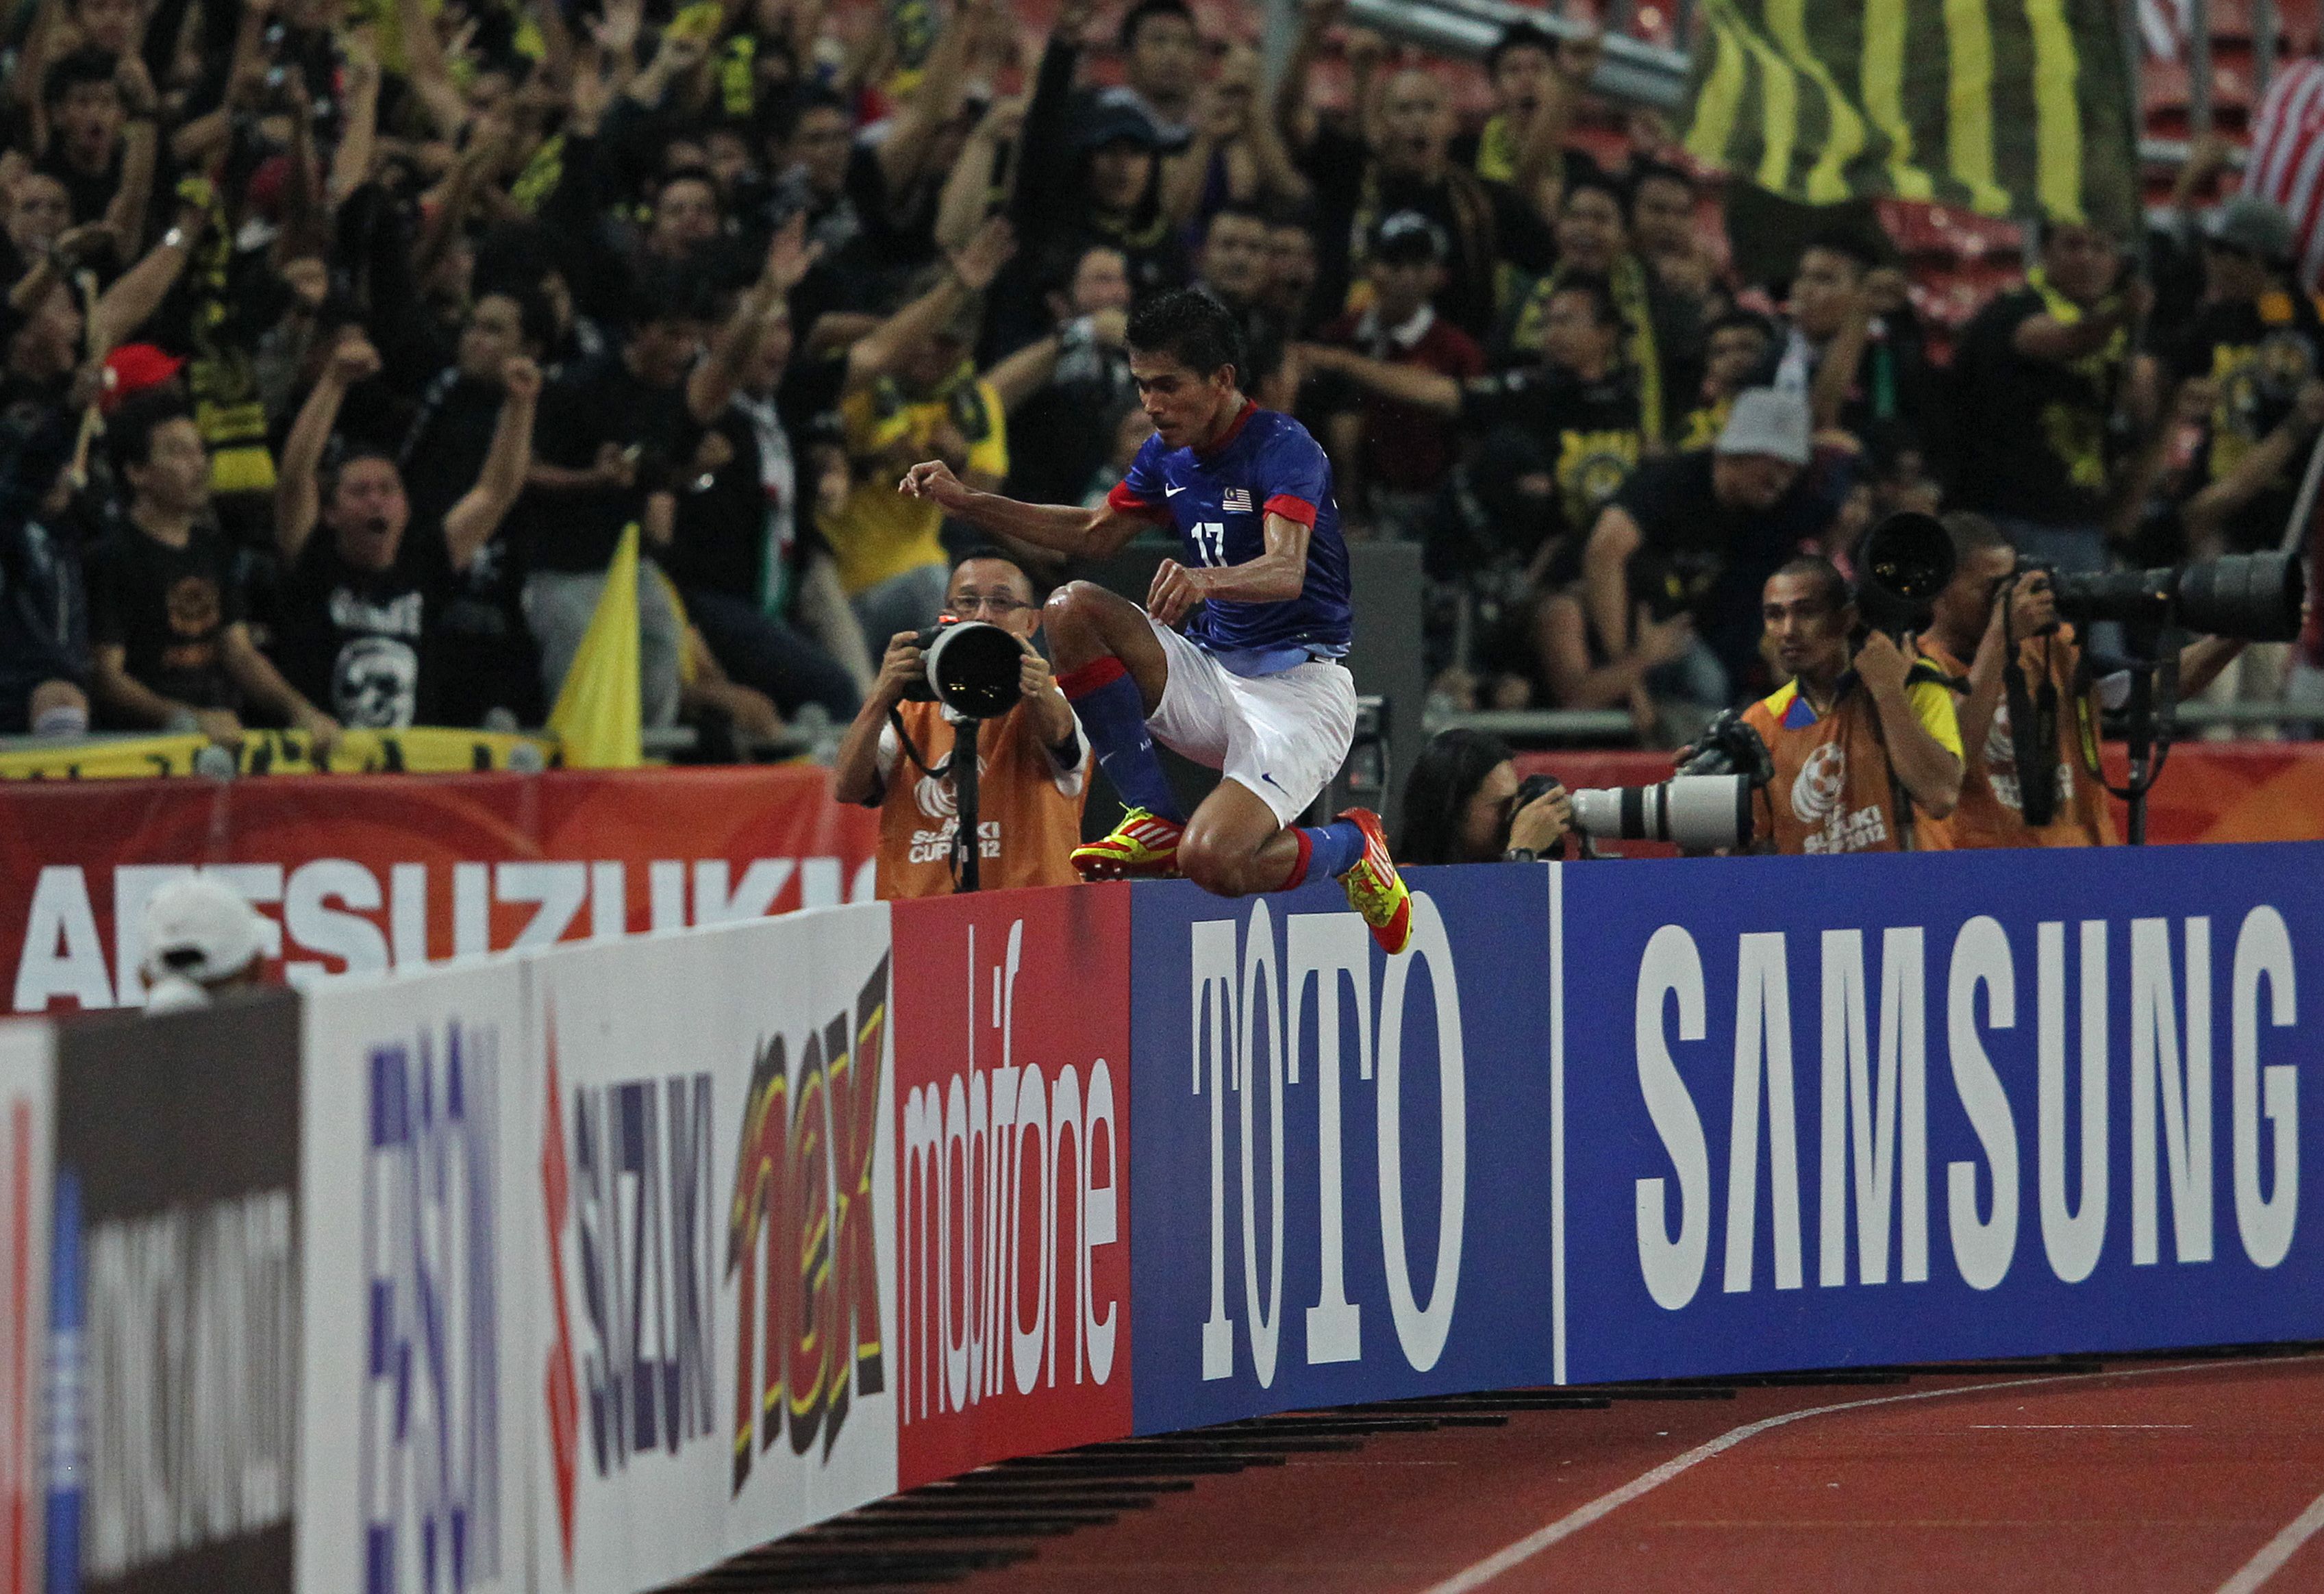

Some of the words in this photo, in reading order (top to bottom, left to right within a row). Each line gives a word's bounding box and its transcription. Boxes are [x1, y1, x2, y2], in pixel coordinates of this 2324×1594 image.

[1190, 522, 1228, 567] 17
[909, 843, 953, 863] CUP
[911, 821, 1000, 845] SUZKI
[574, 1070, 714, 1480] SUZUKI
[903, 919, 1117, 1425] mobifone
[1191, 891, 1466, 1389] TOTO
[1635, 905, 2299, 1310] SAMSUNG
